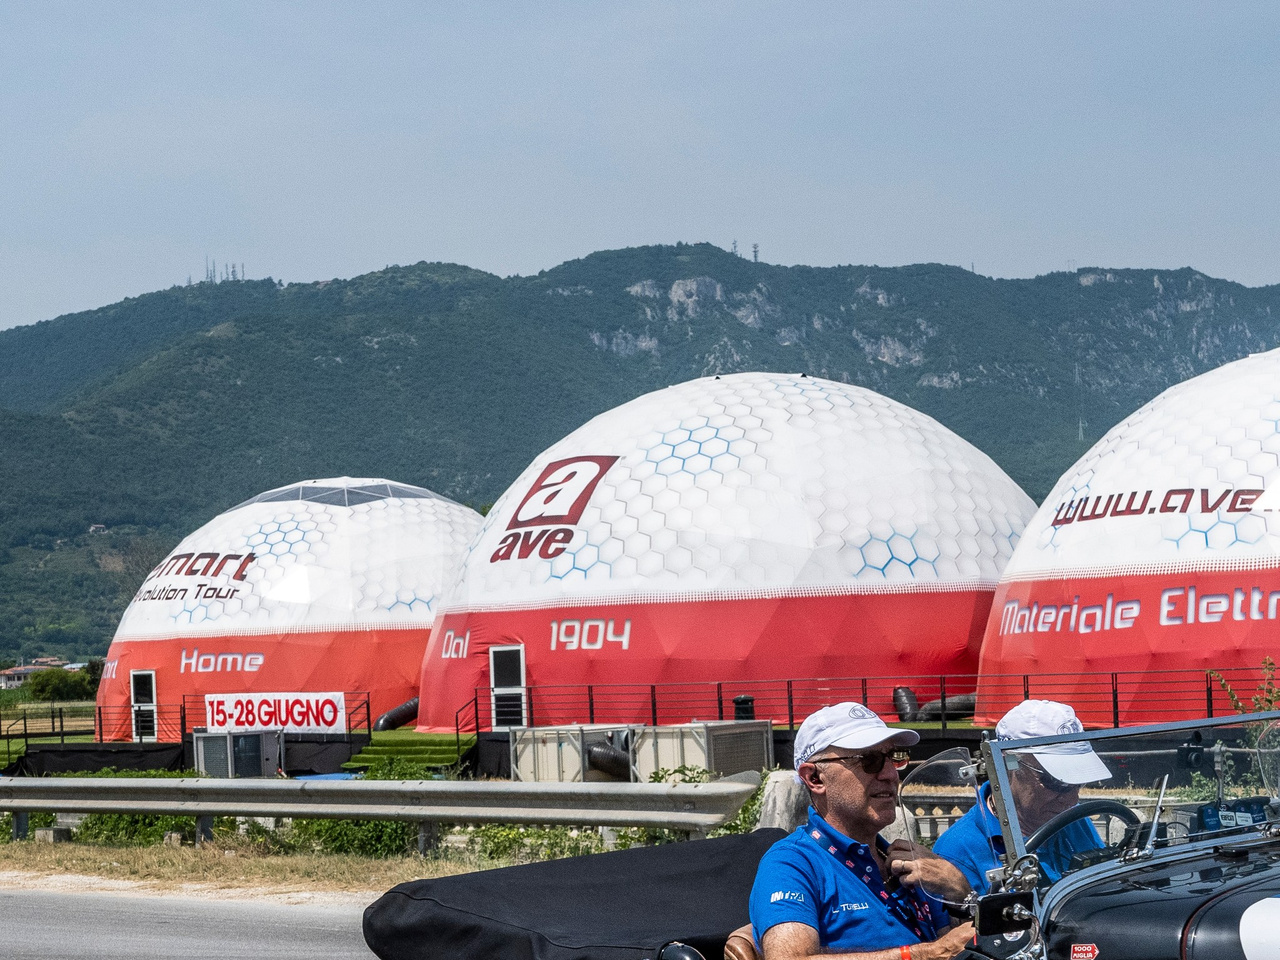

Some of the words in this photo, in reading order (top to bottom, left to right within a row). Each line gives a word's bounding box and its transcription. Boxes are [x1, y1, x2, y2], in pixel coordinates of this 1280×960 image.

[489, 528, 574, 563] ave
[194, 584, 240, 600] Tour
[999, 592, 1141, 636] Materiale
[441, 628, 471, 659] Dal
[550, 618, 632, 650] 1904
[180, 647, 265, 674] Home
[208, 699, 256, 727] 15-28
[258, 698, 338, 727] GIUGNO
